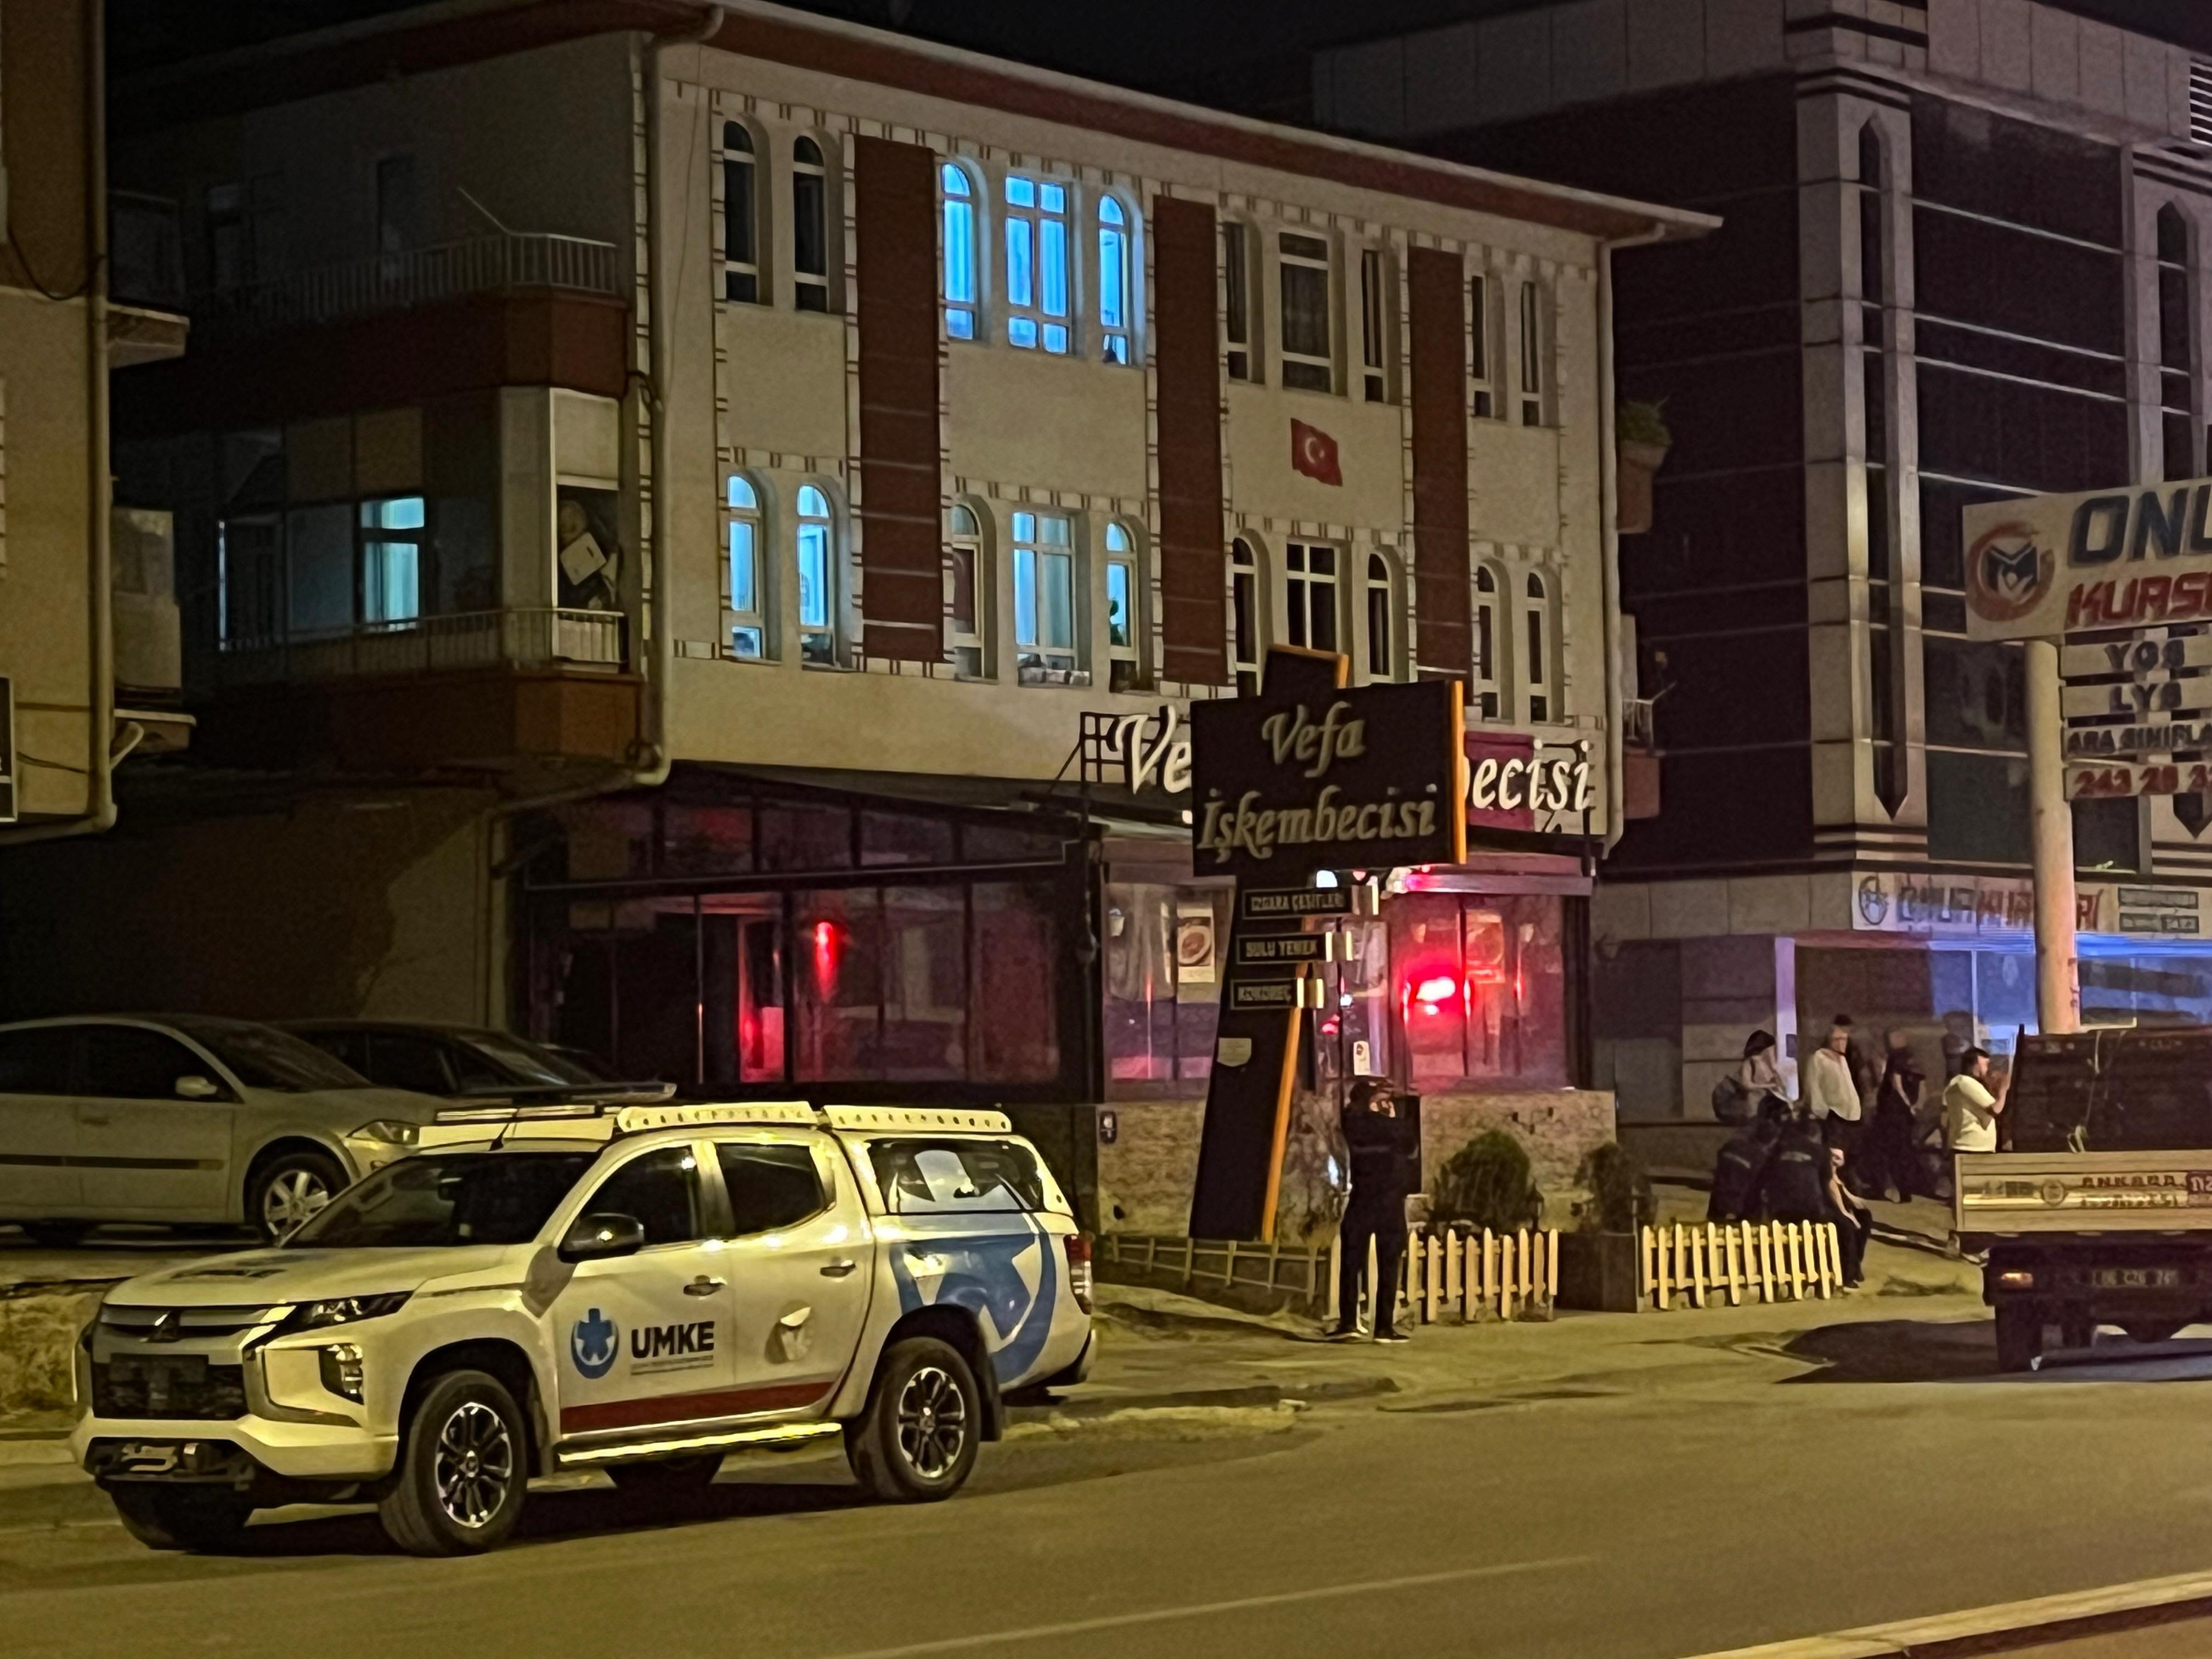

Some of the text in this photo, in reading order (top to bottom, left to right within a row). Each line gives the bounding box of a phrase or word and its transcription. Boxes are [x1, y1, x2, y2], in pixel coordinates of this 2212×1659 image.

[2064, 571, 2212, 630] KURS
[1115, 704, 1191, 794] Ve
[1262, 700, 1366, 778] Vefa
[1197, 783, 1437, 864] İşkembecisi
[2083, 1175, 2175, 1188] ANKARA
[631, 1321, 714, 1358] UMKE
